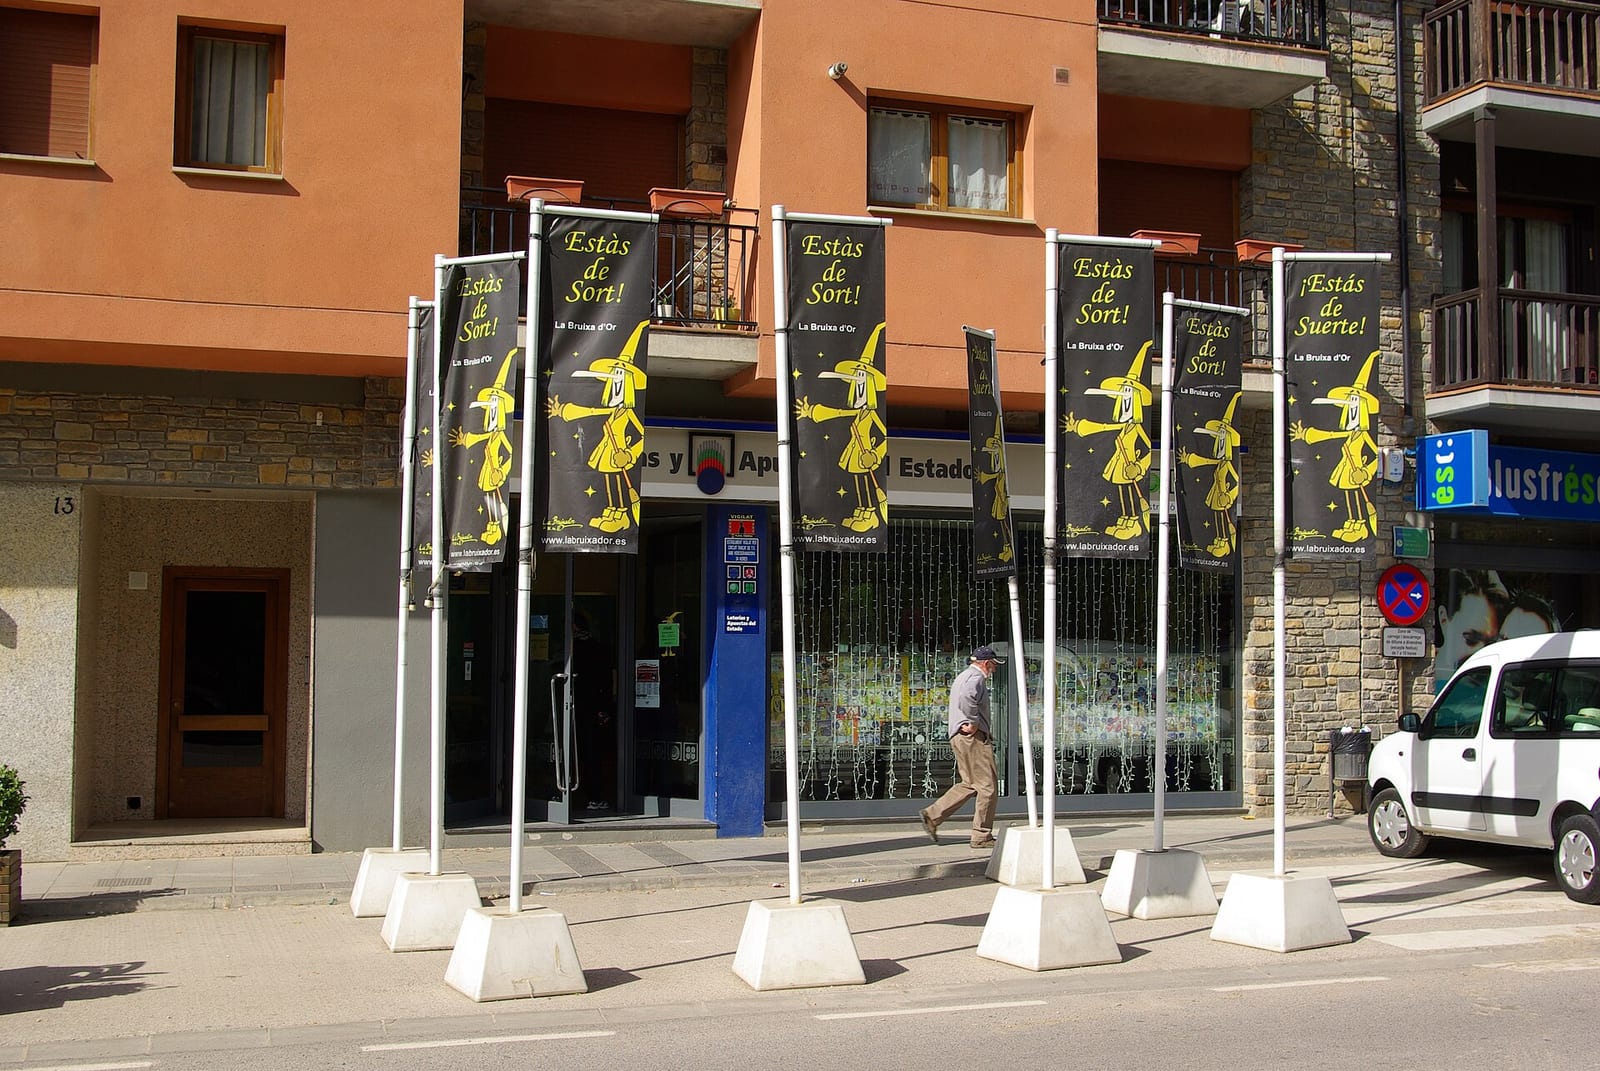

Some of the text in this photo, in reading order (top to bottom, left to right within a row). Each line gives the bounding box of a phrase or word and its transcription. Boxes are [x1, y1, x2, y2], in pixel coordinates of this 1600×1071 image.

[565, 231, 631, 256] Estàs
[802, 235, 864, 258] Estàs
[584, 257, 609, 281] de
[822, 259, 847, 282] de
[1073, 258, 1134, 280] Estàs
[457, 273, 503, 298] Estàs
[565, 281, 625, 304] Sort!
[806, 282, 861, 305] Sort!
[1091, 281, 1115, 303] de
[1300, 273, 1365, 296] ¡Estás
[472, 296, 488, 320] de
[1076, 302, 1130, 325] Sort!
[1319, 296, 1343, 317] de
[459, 317, 498, 342] Sort!
[555, 321, 617, 332] La Bruixa d'Or
[798, 322, 856, 333] La Bruixa d'Or
[1186, 317, 1230, 339] Estàs
[1294, 316, 1367, 337] Suerte!
[1067, 341, 1124, 351] La Bruixa d'Or
[1198, 338, 1217, 358] de
[453, 359, 462, 367] La
[1187, 355, 1226, 377] Sort!
[1294, 353, 1351, 362] La Bruixa d'Or
[669, 453, 684, 474] y
[900, 457, 972, 480] Estado
[1488, 459, 1600, 505] lusfrés
[54, 497, 74, 515] 13
[541, 535, 627, 546] www.labruixador.es
